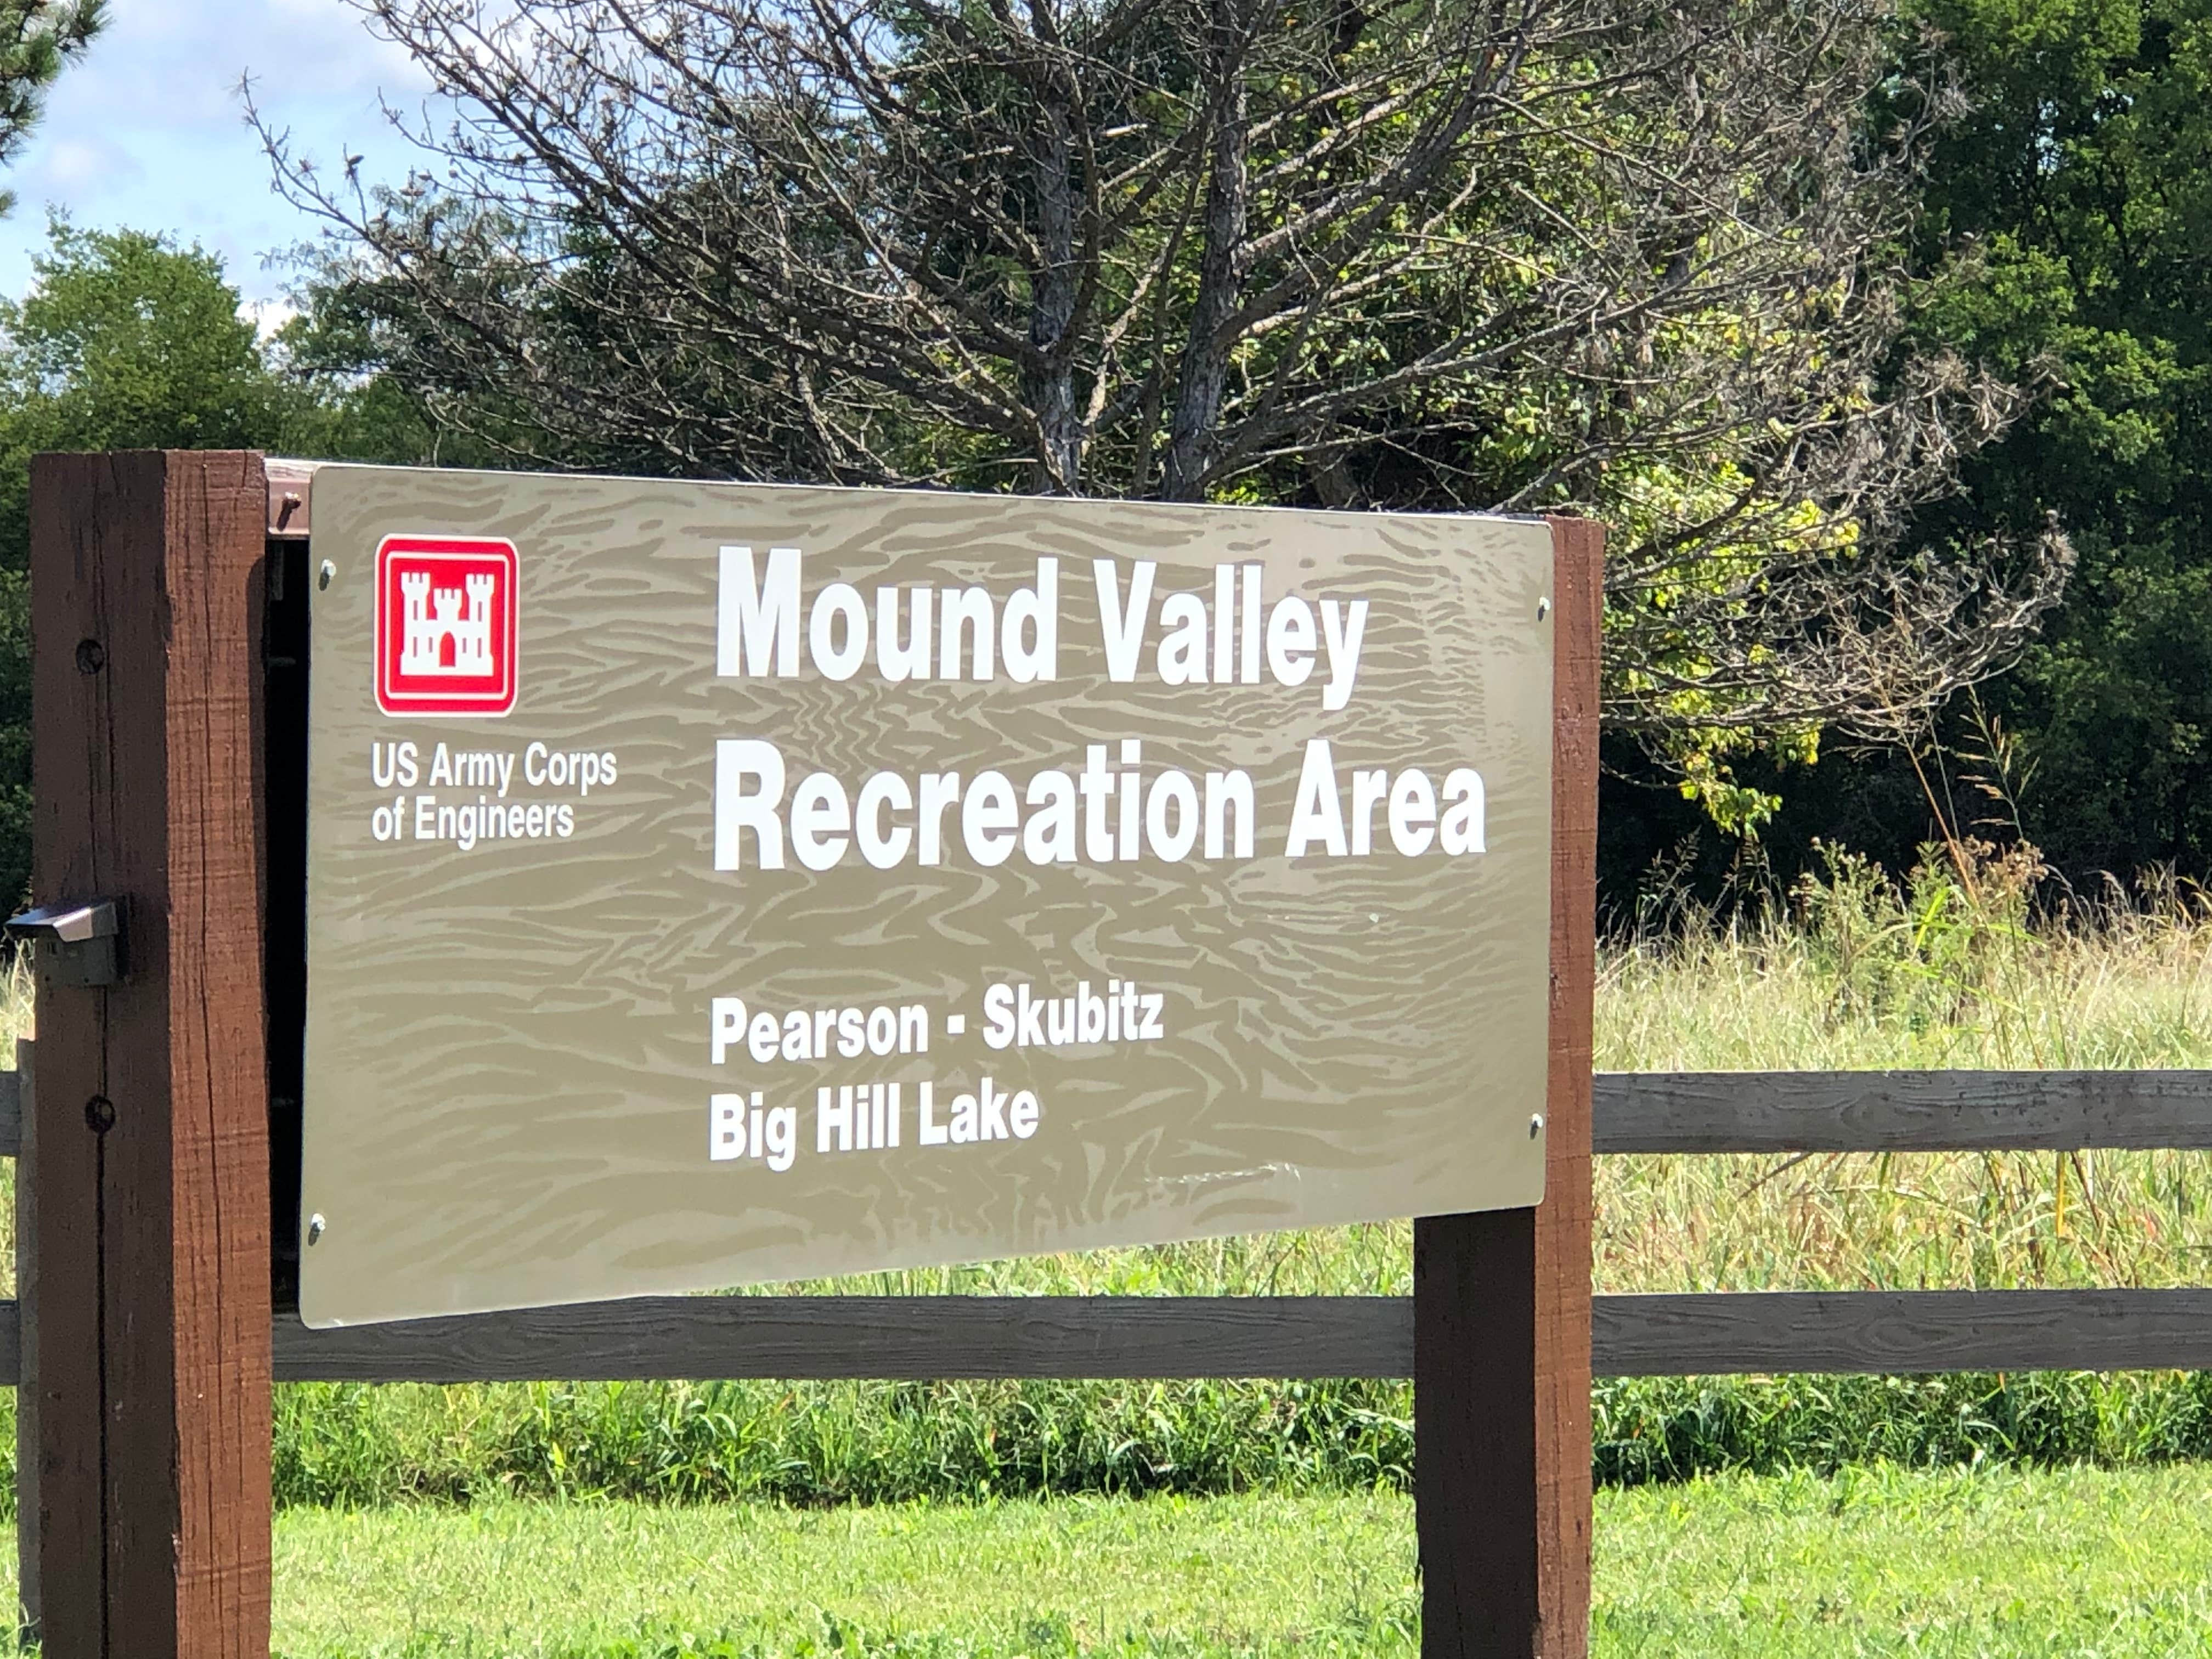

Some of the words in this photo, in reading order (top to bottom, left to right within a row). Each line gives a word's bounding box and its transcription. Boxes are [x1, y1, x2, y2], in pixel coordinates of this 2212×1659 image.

[716, 546, 1058, 684] Mound
[1093, 558, 1369, 711] Valley
[373, 742, 419, 787] US
[428, 742, 515, 798] Army
[525, 741, 617, 797] Corps
[714, 739, 1255, 871] Recreation
[1285, 739, 1487, 857] Area
[373, 795, 405, 840] of
[415, 795, 574, 851] Engineers
[711, 997, 929, 1064] Pearson
[947, 1015, 965, 1034] -
[983, 979, 1164, 1049] Skubitz
[710, 1092, 797, 1172] Big
[817, 1082, 900, 1153] Hill
[919, 1077, 1039, 1146] Lake
